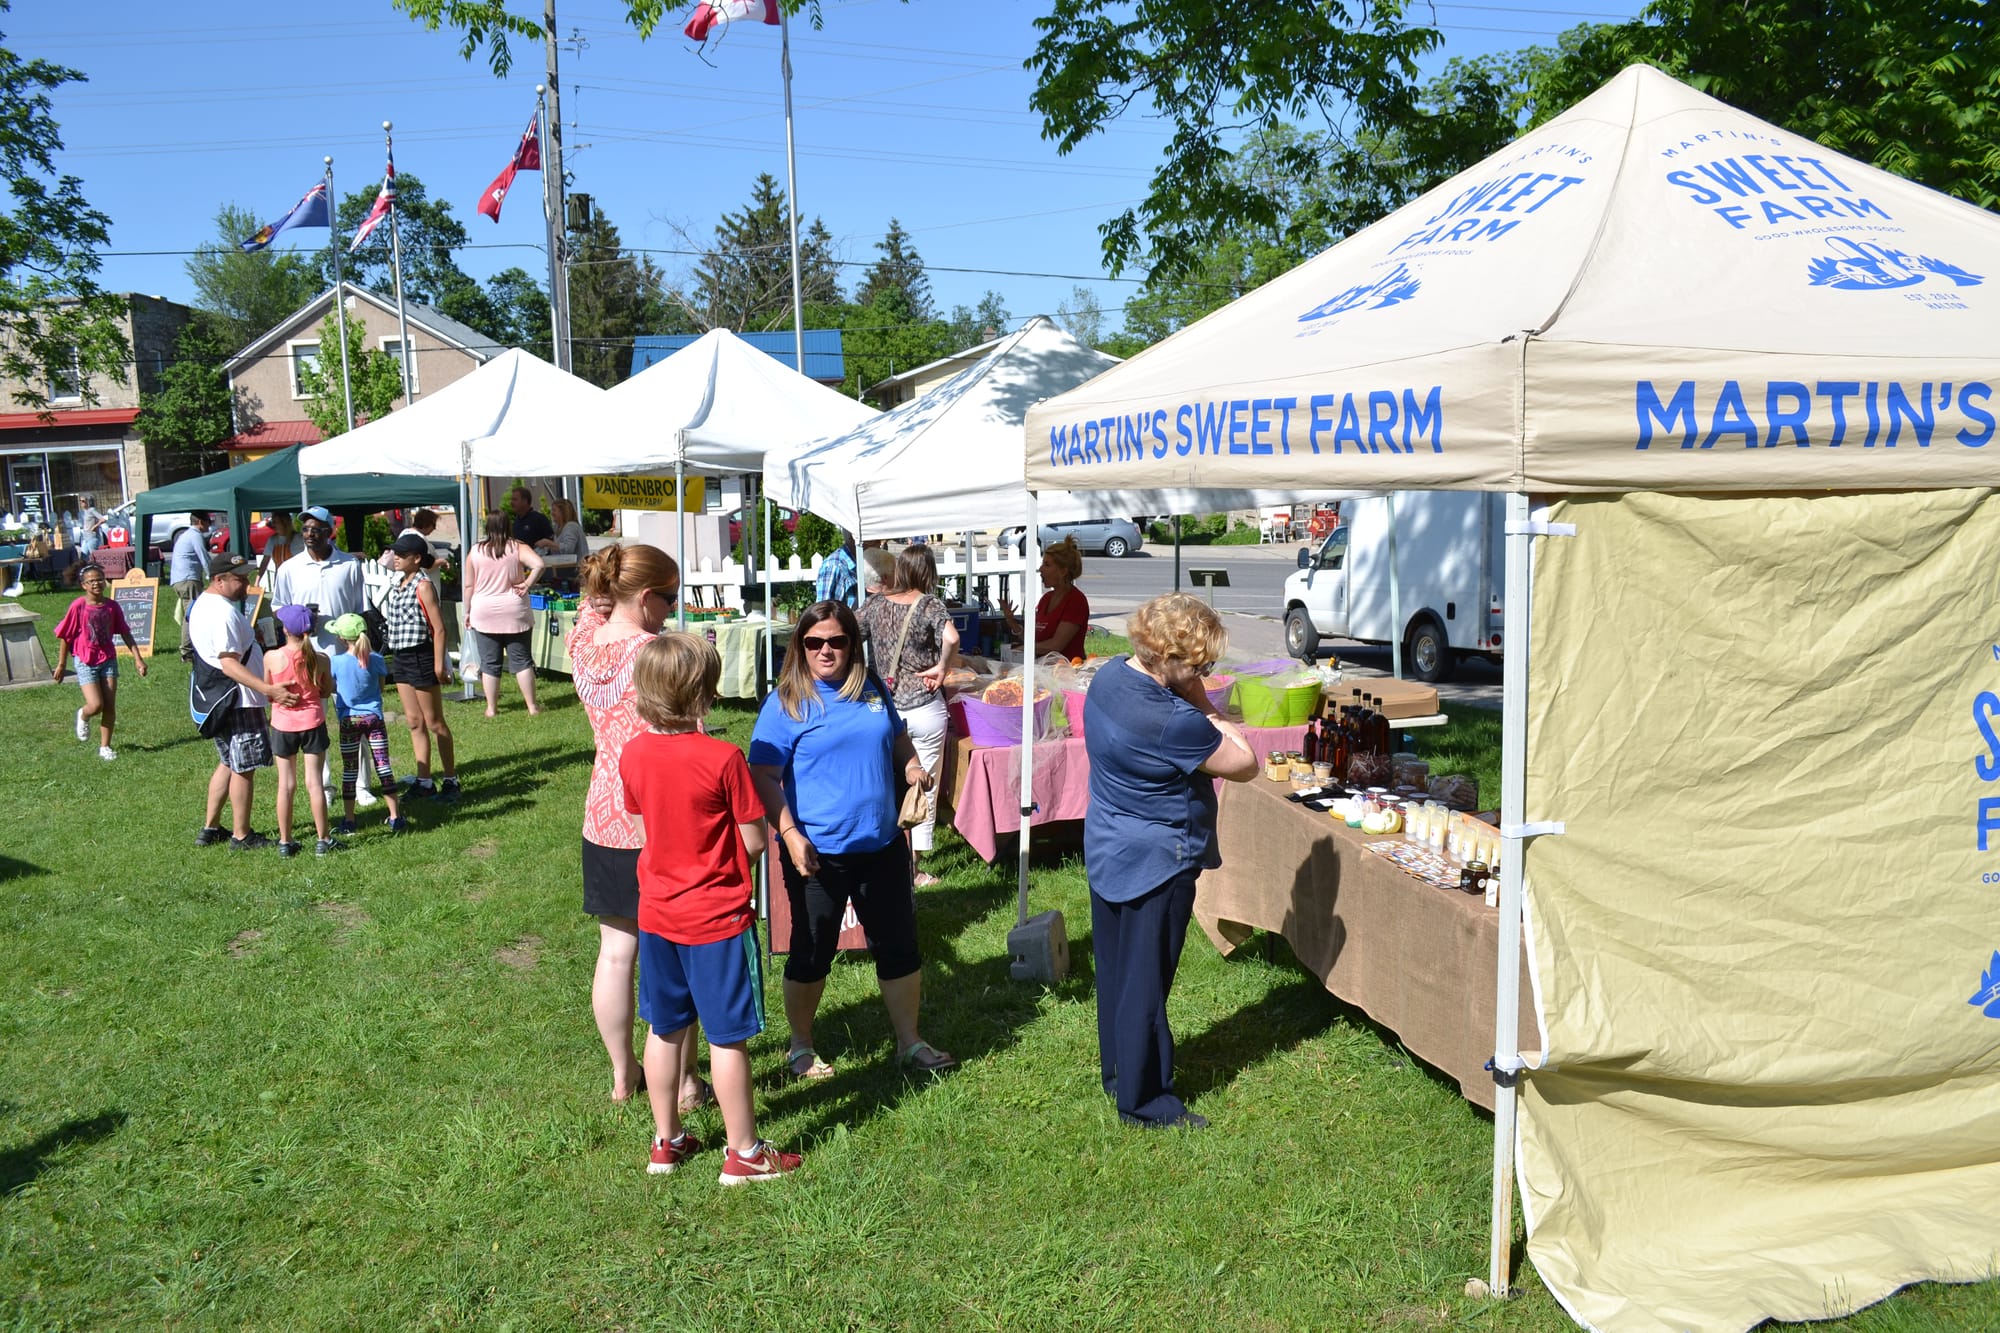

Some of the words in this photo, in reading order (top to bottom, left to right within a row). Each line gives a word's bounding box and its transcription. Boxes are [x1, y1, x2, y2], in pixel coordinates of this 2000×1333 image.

[1499, 143, 1593, 170] MARTIN'S
[1662, 129, 1781, 158] MARTIN'S
[1666, 154, 1853, 205] SWEET
[1424, 172, 1587, 226] SWEET
[1712, 195, 1893, 230] FARM
[1386, 217, 1523, 256] FARM
[1753, 231, 1790, 241] GOOD
[1050, 408, 1169, 467] MARTIN'S
[1175, 396, 1298, 457] SWEET
[1309, 385, 1443, 455] FARM
[1635, 380, 1997, 450] MARTIN'S
[594, 477, 690, 498] VANDENBRO
[618, 496, 643, 506] FAMILY
[644, 497, 663, 507] FARM
